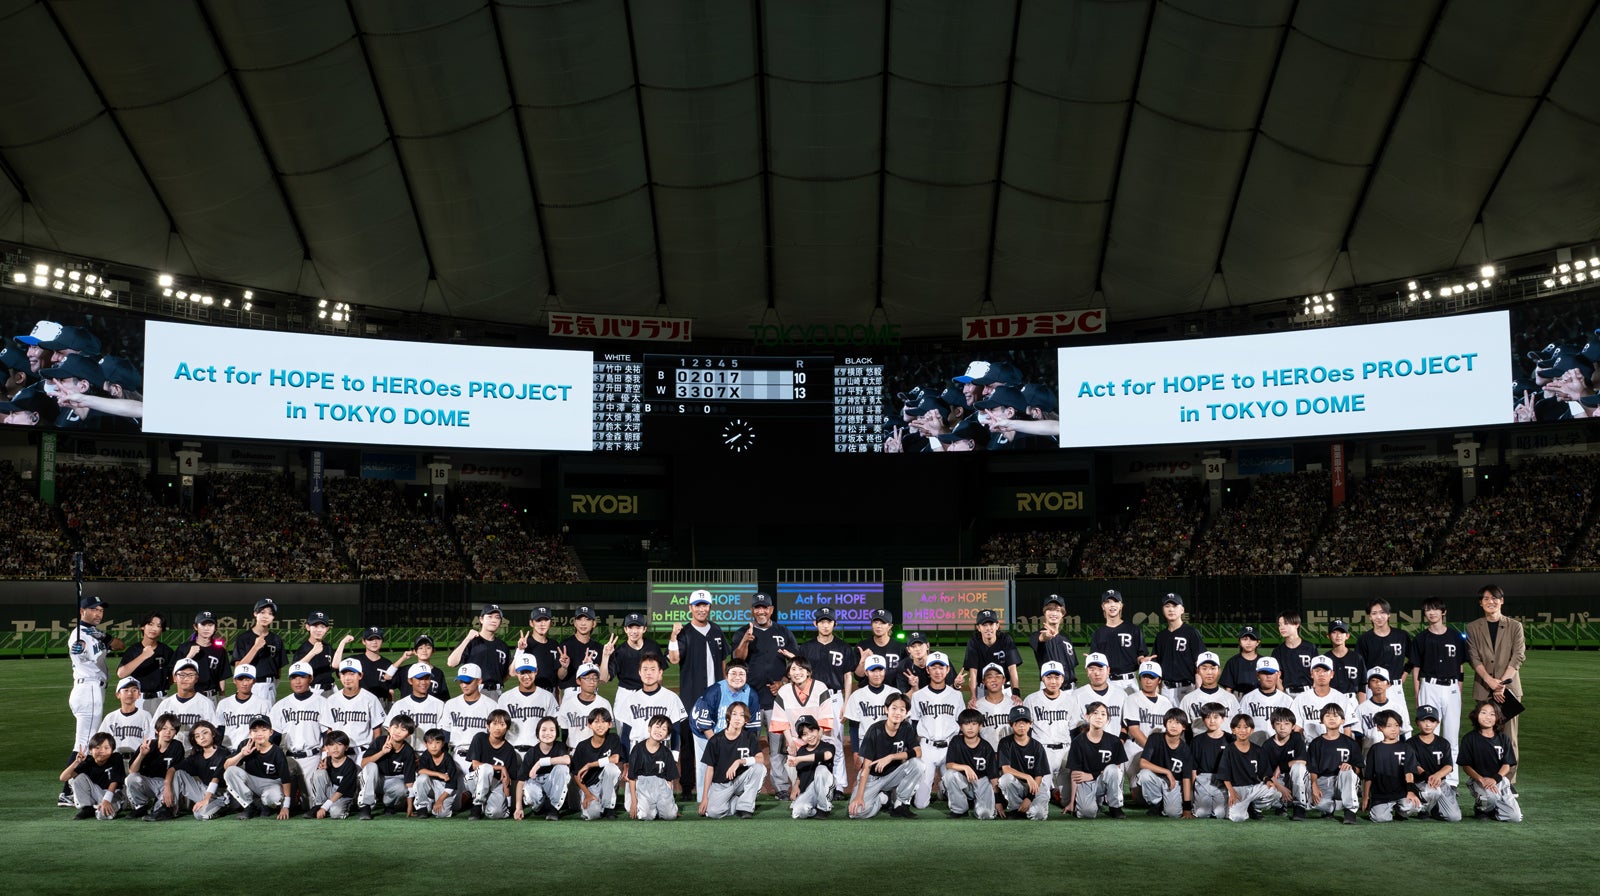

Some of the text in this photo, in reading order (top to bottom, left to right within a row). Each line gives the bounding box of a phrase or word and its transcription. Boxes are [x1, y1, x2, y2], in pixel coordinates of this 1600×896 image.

[551, 315, 690, 341] 元気ハツラツ!
[966, 310, 1102, 339] オロナミンC
[749, 324, 902, 347] TOKYO DOME
[693, 359, 699, 367] 2
[705, 359, 712, 367] 3
[731, 360, 738, 368] 5
[796, 360, 804, 368] R
[658, 371, 806, 384] B 0 2 0 1 7 10
[1078, 353, 1478, 398] Act for HOPE to HEROes PROJECT
[174, 362, 573, 402] Act for HOPE to HEROes PROJECT
[656, 386, 806, 399] W 3 3 0 7 X 13
[848, 387, 863, 395] 平野
[645, 404, 651, 412] B
[679, 405, 685, 413] S
[1180, 394, 1366, 422] in TOKYO DOME
[286, 401, 471, 427] in TOKYO DOME
[606, 422, 622, 431] 鈴木
[625, 422, 641, 431] 大河
[848, 425, 867, 433] 松井
[1517, 432, 1581, 449] 昭和大学
[606, 442, 622, 451] 宮下
[100, 448, 144, 458] OMNIA
[1463, 449, 1471, 459] 3
[185, 458, 192, 467] 4
[1130, 460, 1191, 476] Denyo
[435, 469, 445, 478] 16
[461, 463, 523, 479] Denyo
[1208, 464, 1220, 473] 34
[570, 494, 638, 514] RYOBI
[1016, 491, 1084, 512] RYOBI
[670, 594, 741, 605] Act HOPE
[795, 593, 866, 605] Act for HOPE
[920, 592, 988, 603] Act for HOPE
[652, 611, 662, 621] to
[710, 610, 755, 621] PROJEC
[777, 610, 788, 620] to
[903, 609, 913, 619] to
[915, 608, 956, 619] HEROes
